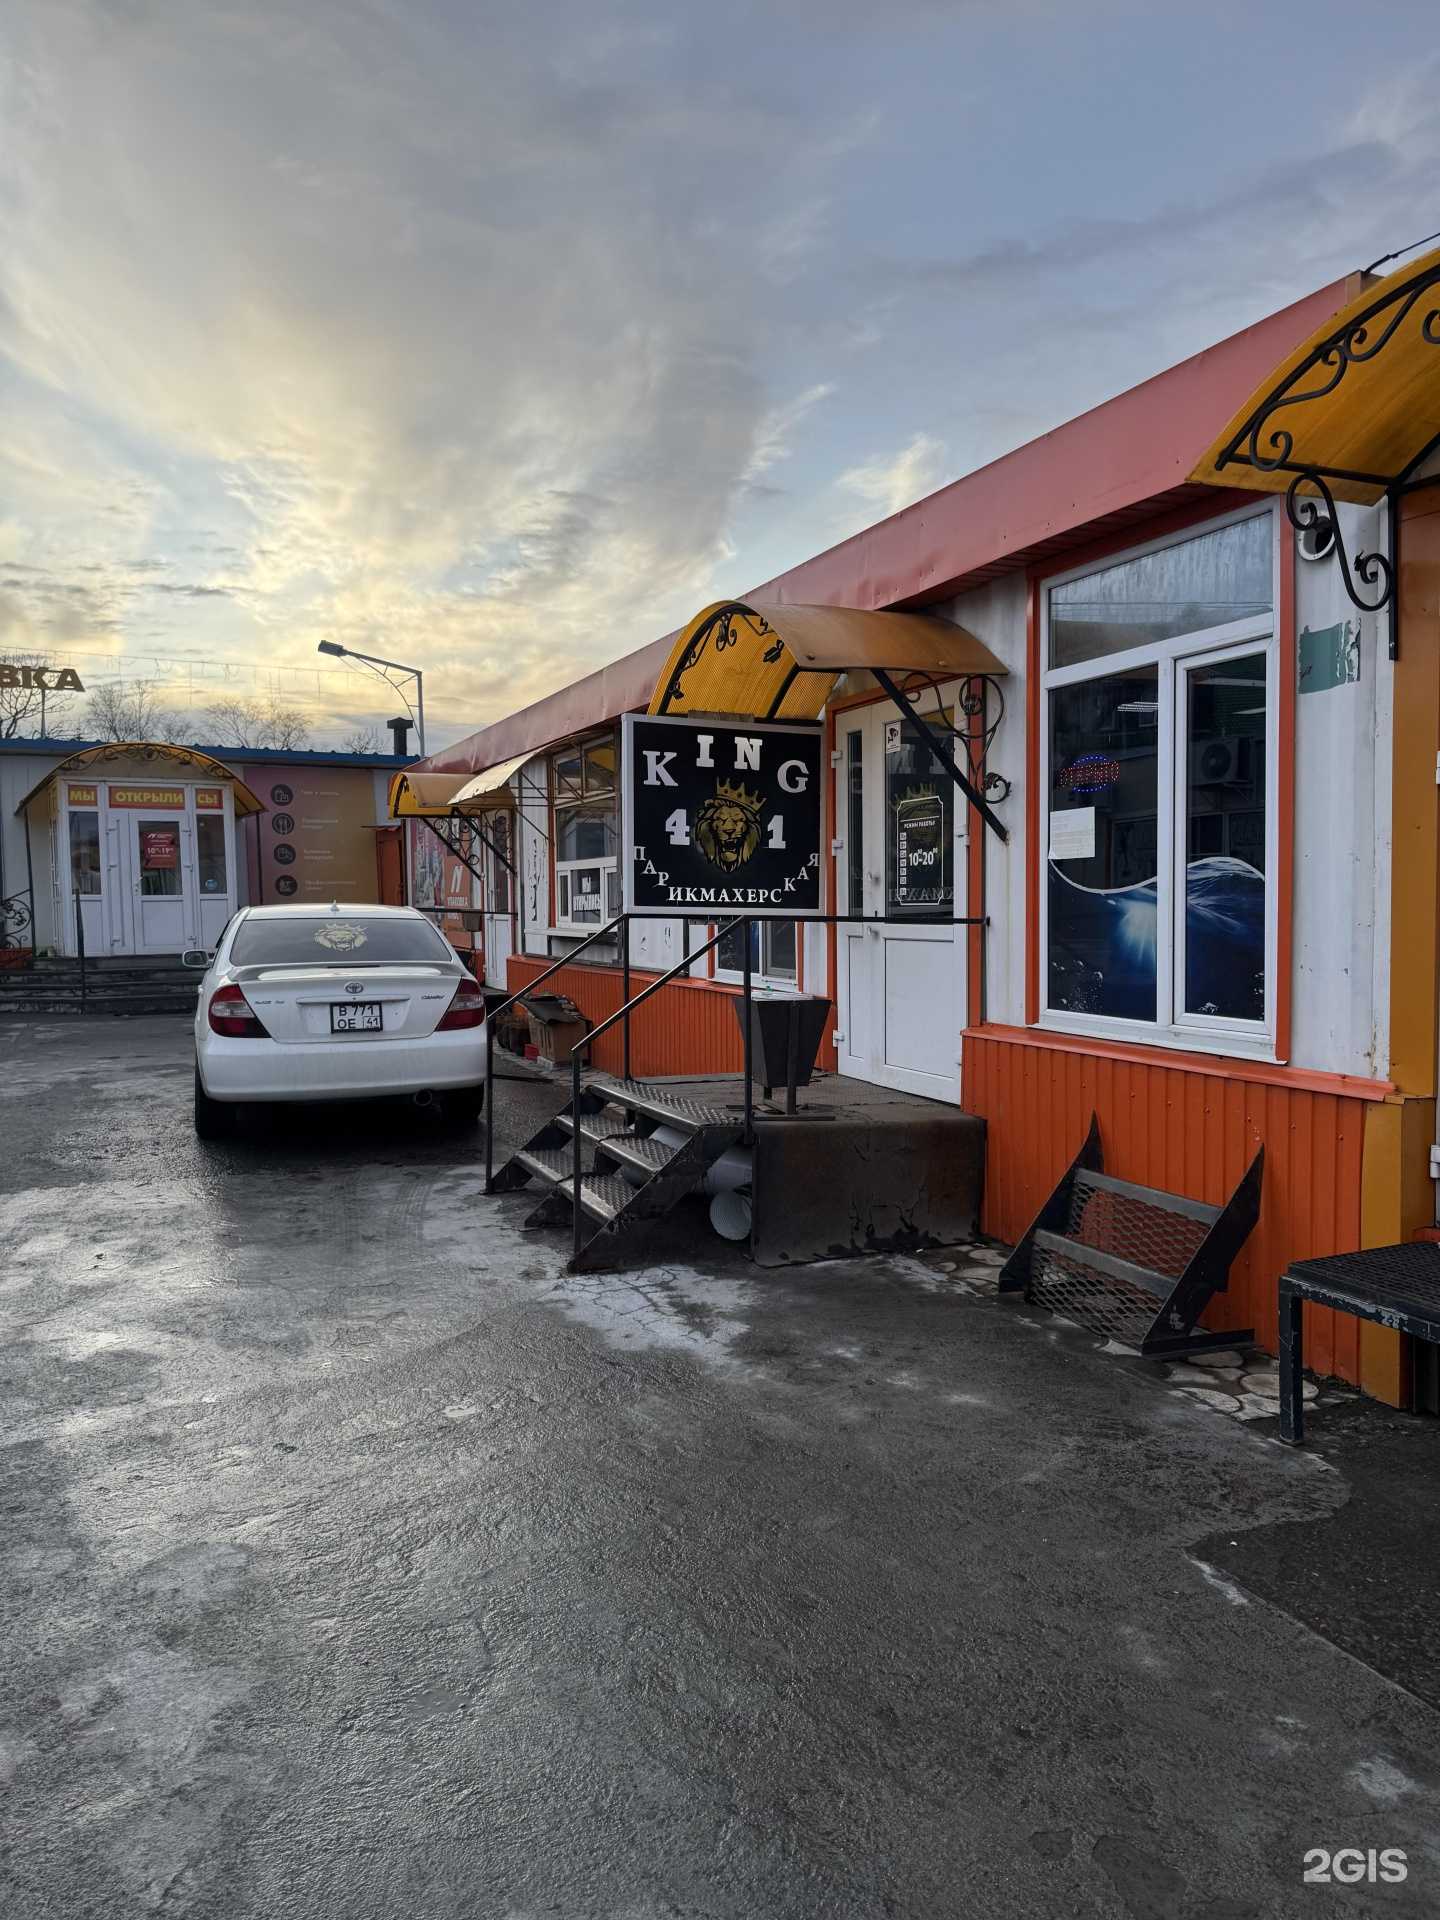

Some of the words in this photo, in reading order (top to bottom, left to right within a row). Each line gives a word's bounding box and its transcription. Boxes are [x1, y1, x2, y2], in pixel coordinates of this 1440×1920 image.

[642, 734, 809, 794] KING
[70, 790, 95, 801] МЫ
[115, 791, 184, 804] ОТКРЫЛИ
[633, 846, 821, 903] ПАРИКМАХЕРСКАЯ
[366, 1017, 379, 1027] 41
